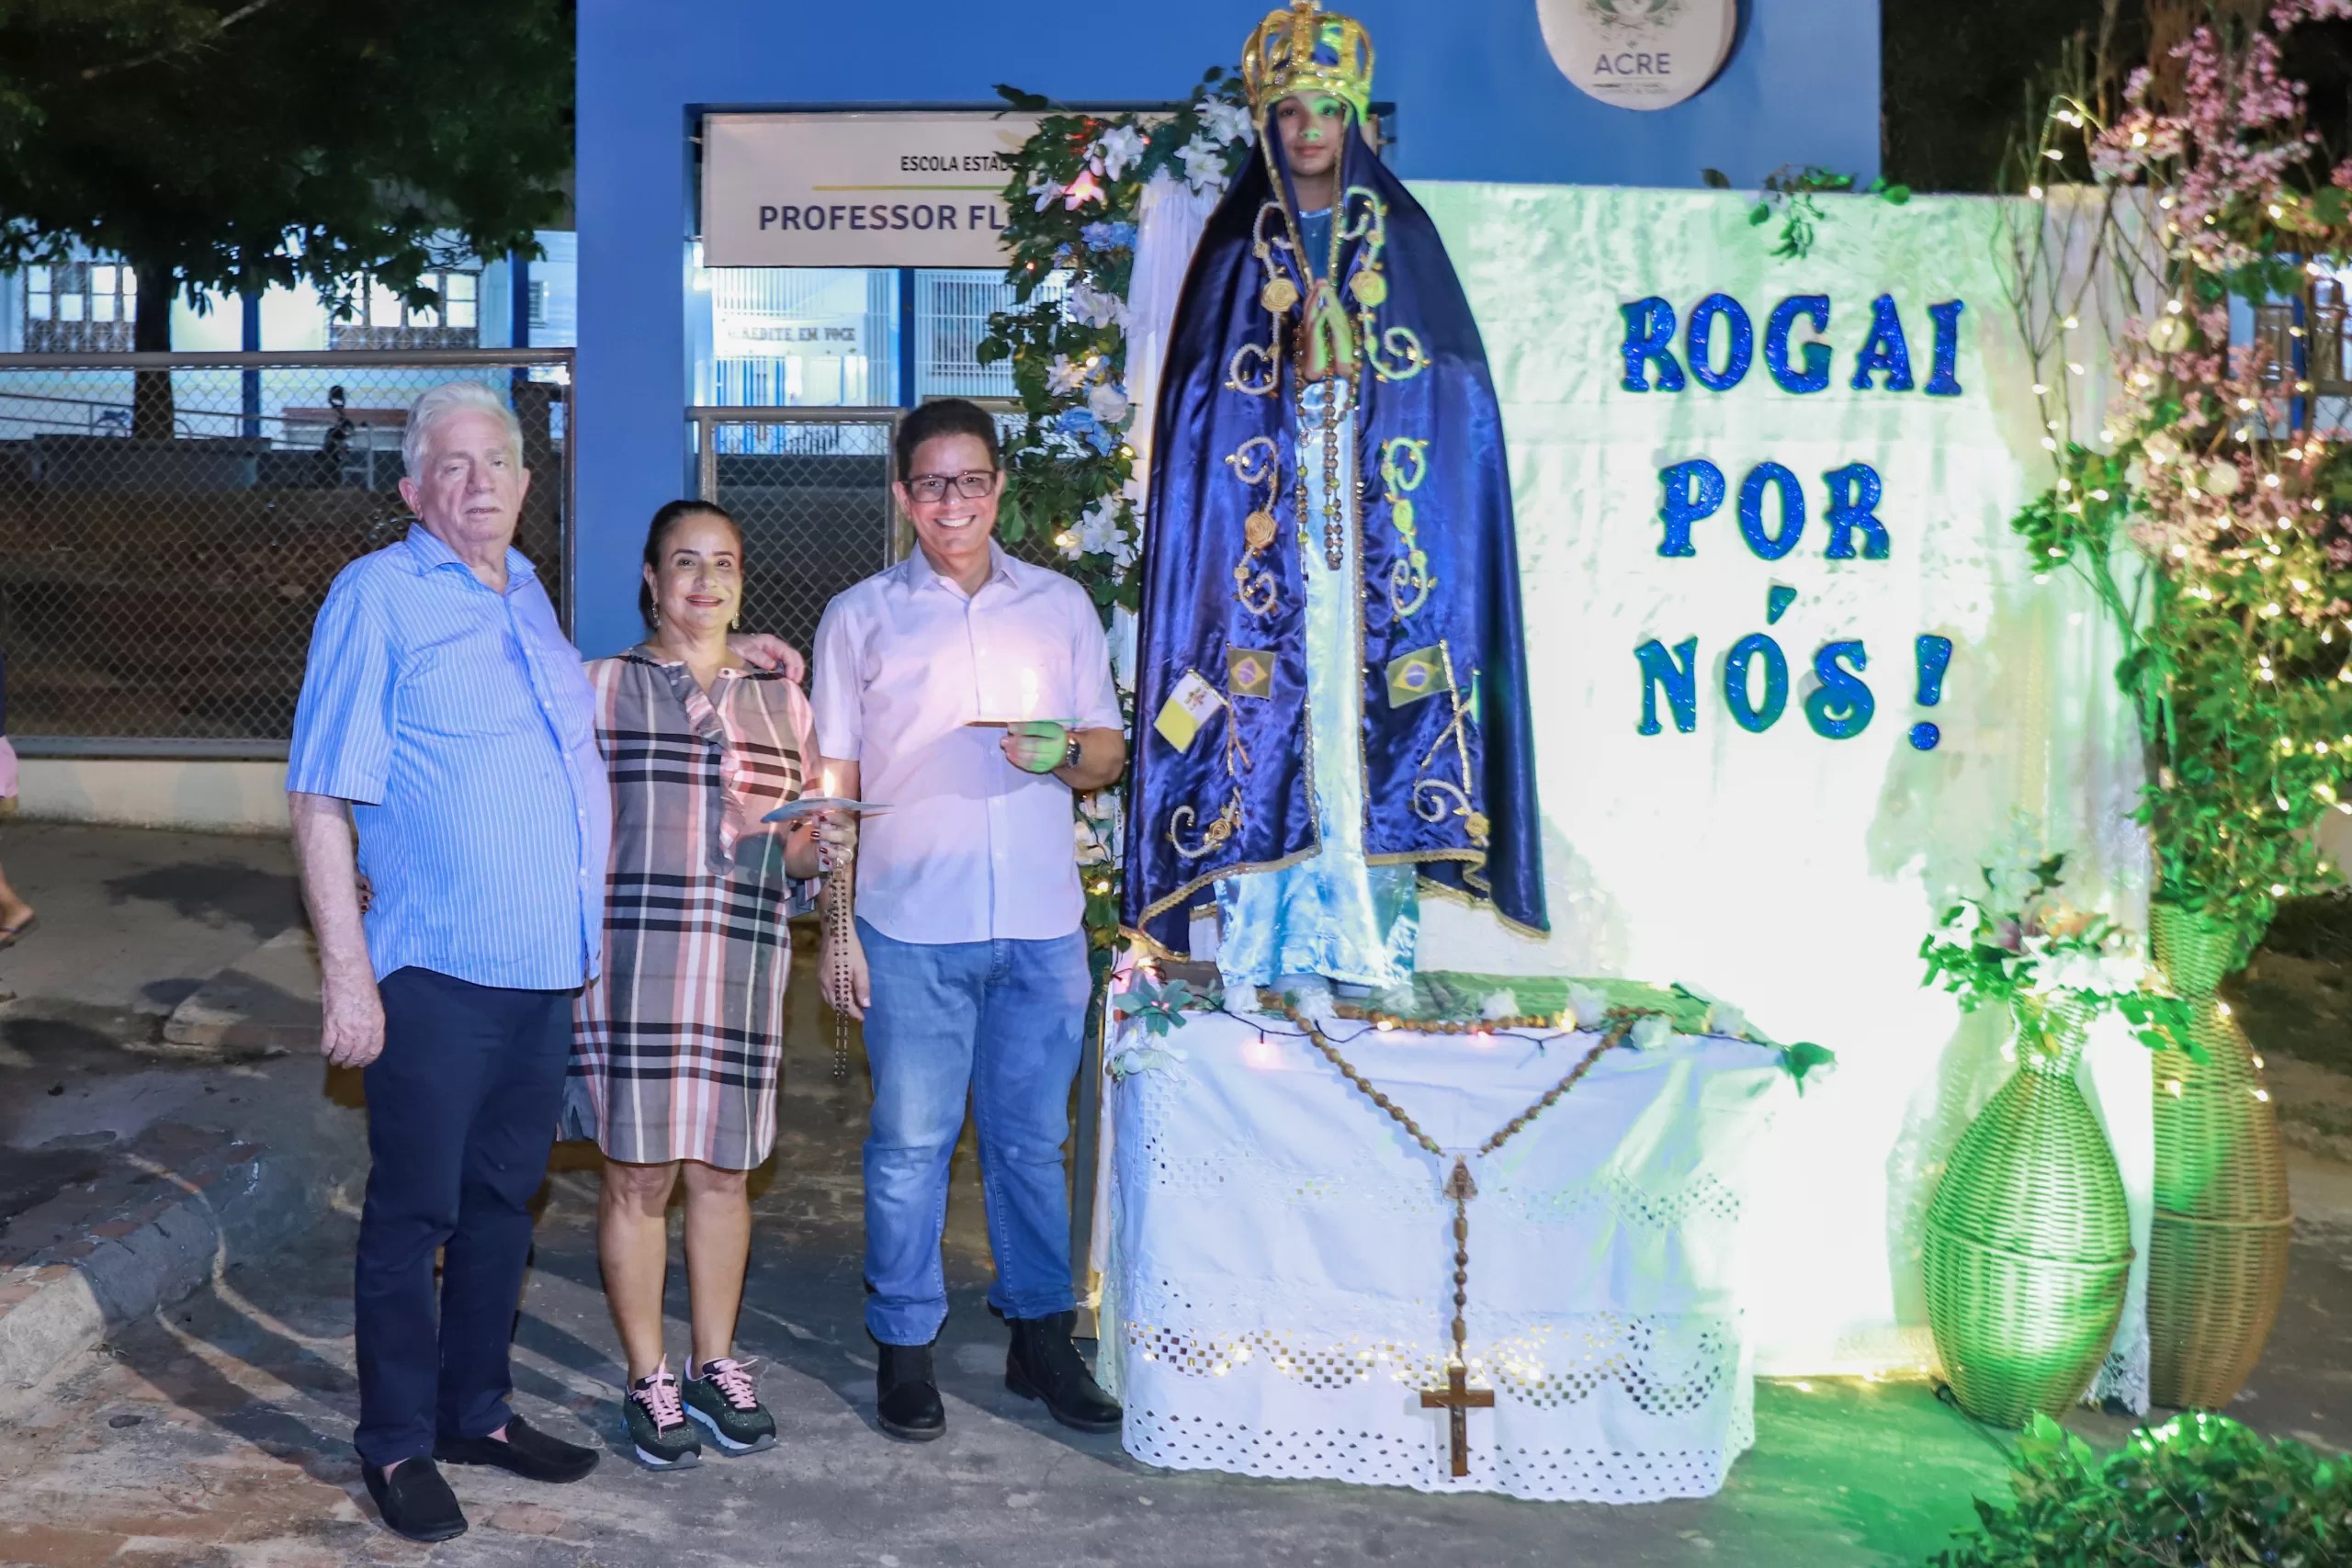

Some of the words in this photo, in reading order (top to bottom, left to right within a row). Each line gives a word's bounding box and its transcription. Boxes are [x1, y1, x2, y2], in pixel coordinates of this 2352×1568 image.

[1593, 52, 1671, 75] ACRE
[900, 155, 958, 172] ESCOLA
[758, 204, 957, 231] PROFESSOR
[1618, 292, 1964, 397] ROGAI
[1656, 458, 1890, 561] POR
